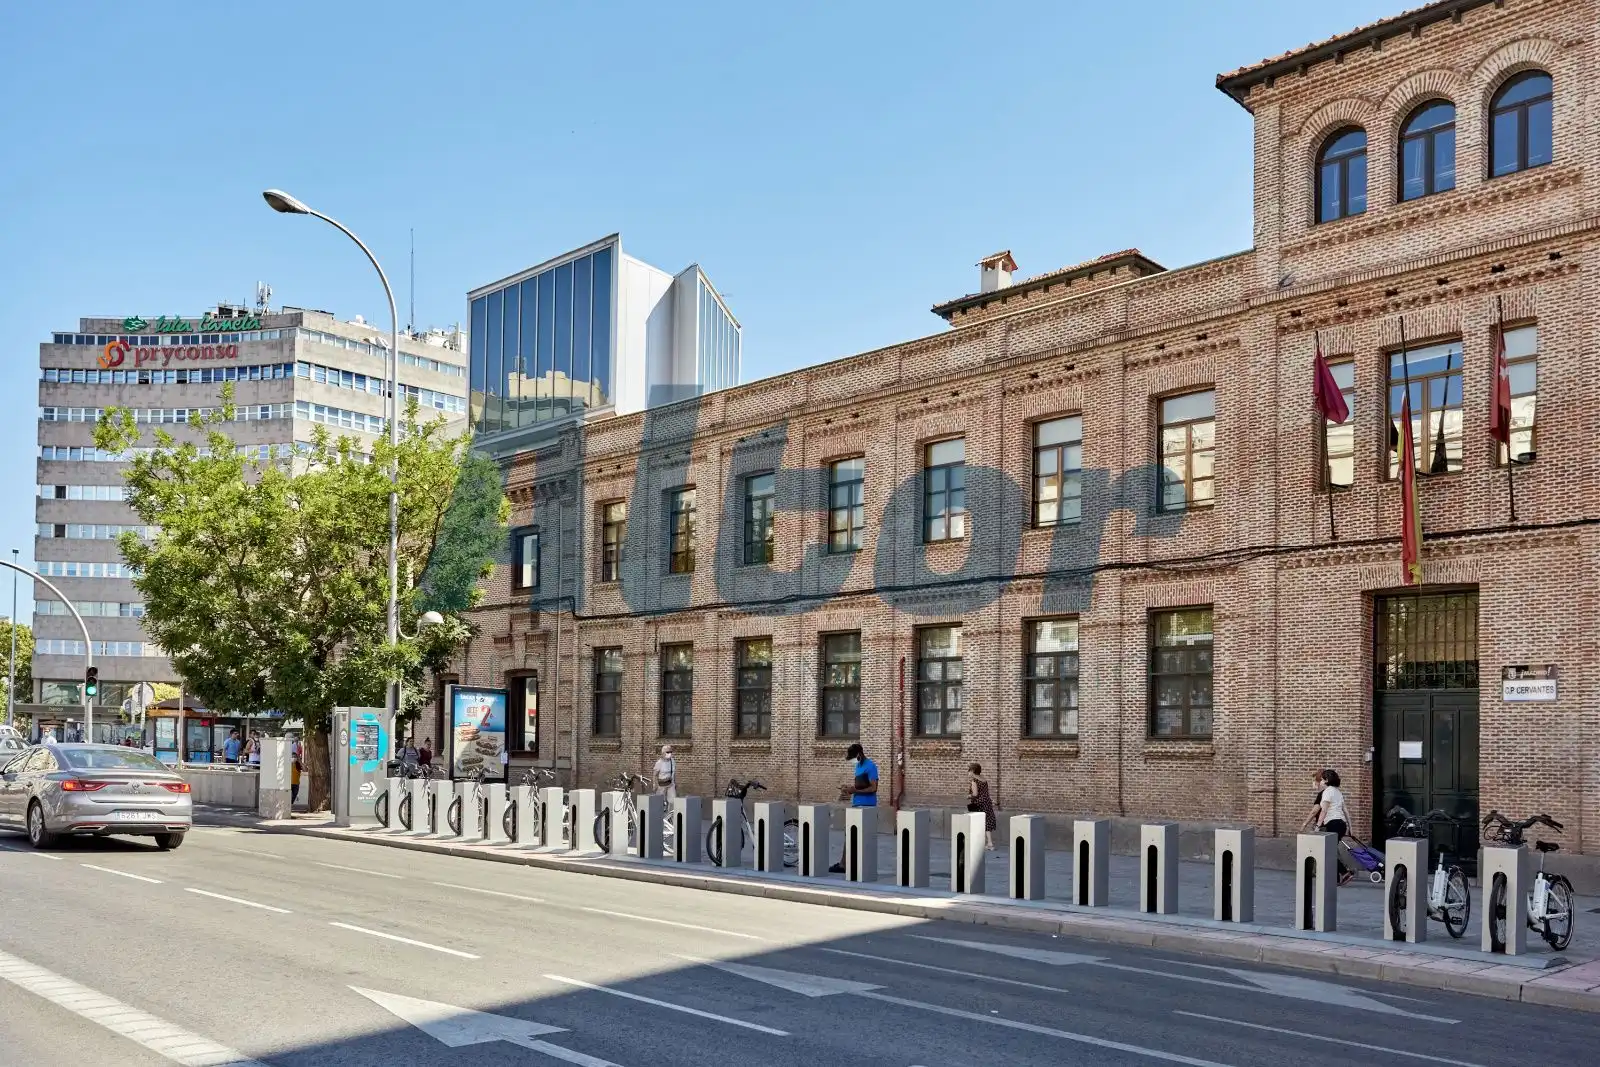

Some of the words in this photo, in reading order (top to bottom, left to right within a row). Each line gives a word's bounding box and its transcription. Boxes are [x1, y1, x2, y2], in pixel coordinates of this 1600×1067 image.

[198, 313, 262, 332] Canela
[134, 344, 239, 367] pryconsa
[1516, 685, 1555, 695] CERVANTES
